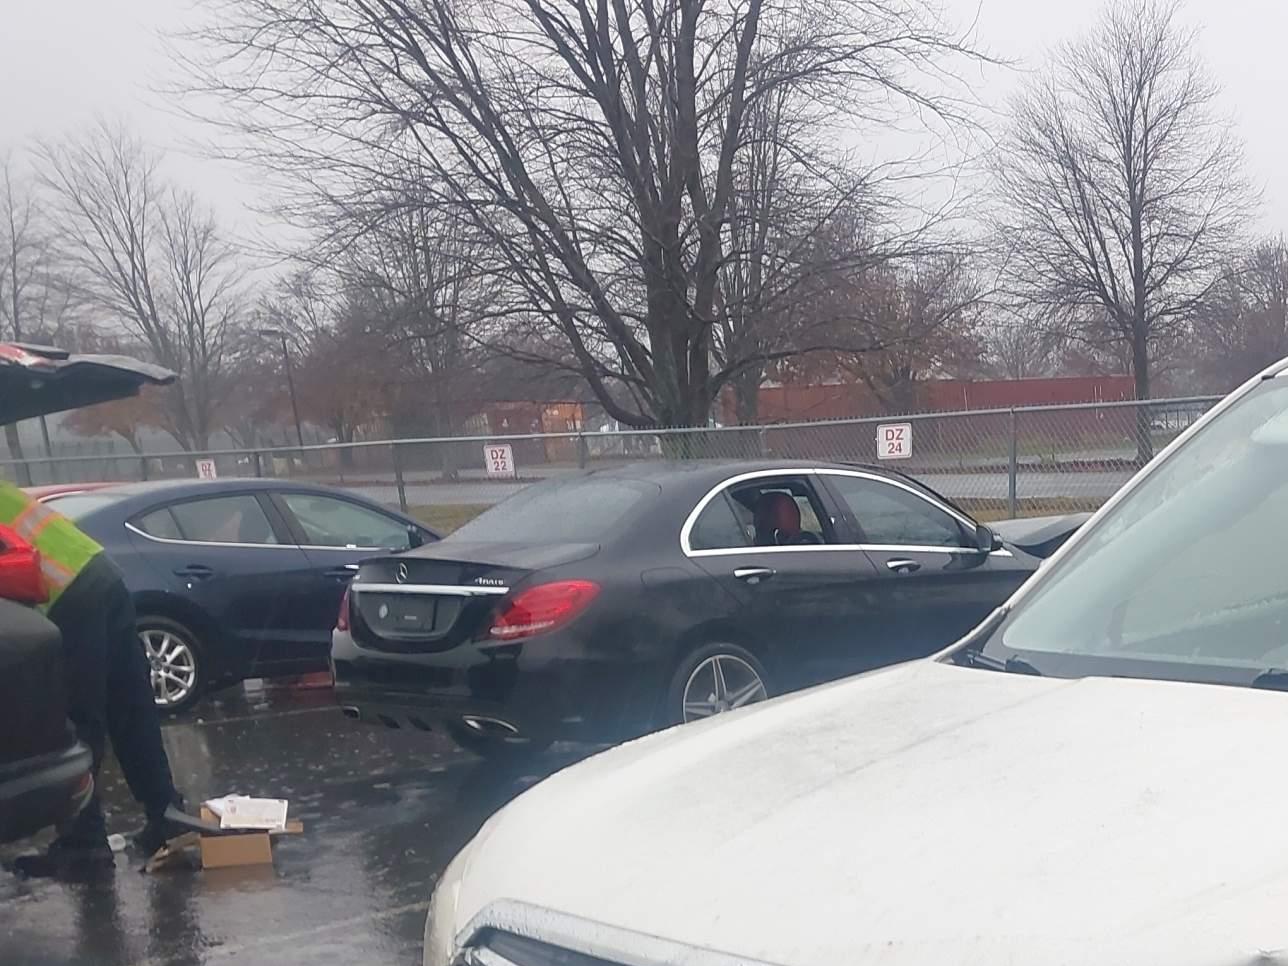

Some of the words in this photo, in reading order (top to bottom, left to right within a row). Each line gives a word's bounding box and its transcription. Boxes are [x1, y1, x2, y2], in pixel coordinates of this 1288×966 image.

[885, 429, 904, 441] DZ
[887, 442, 902, 454] 24
[491, 449, 506, 460] DZ
[493, 460, 507, 471] 22
